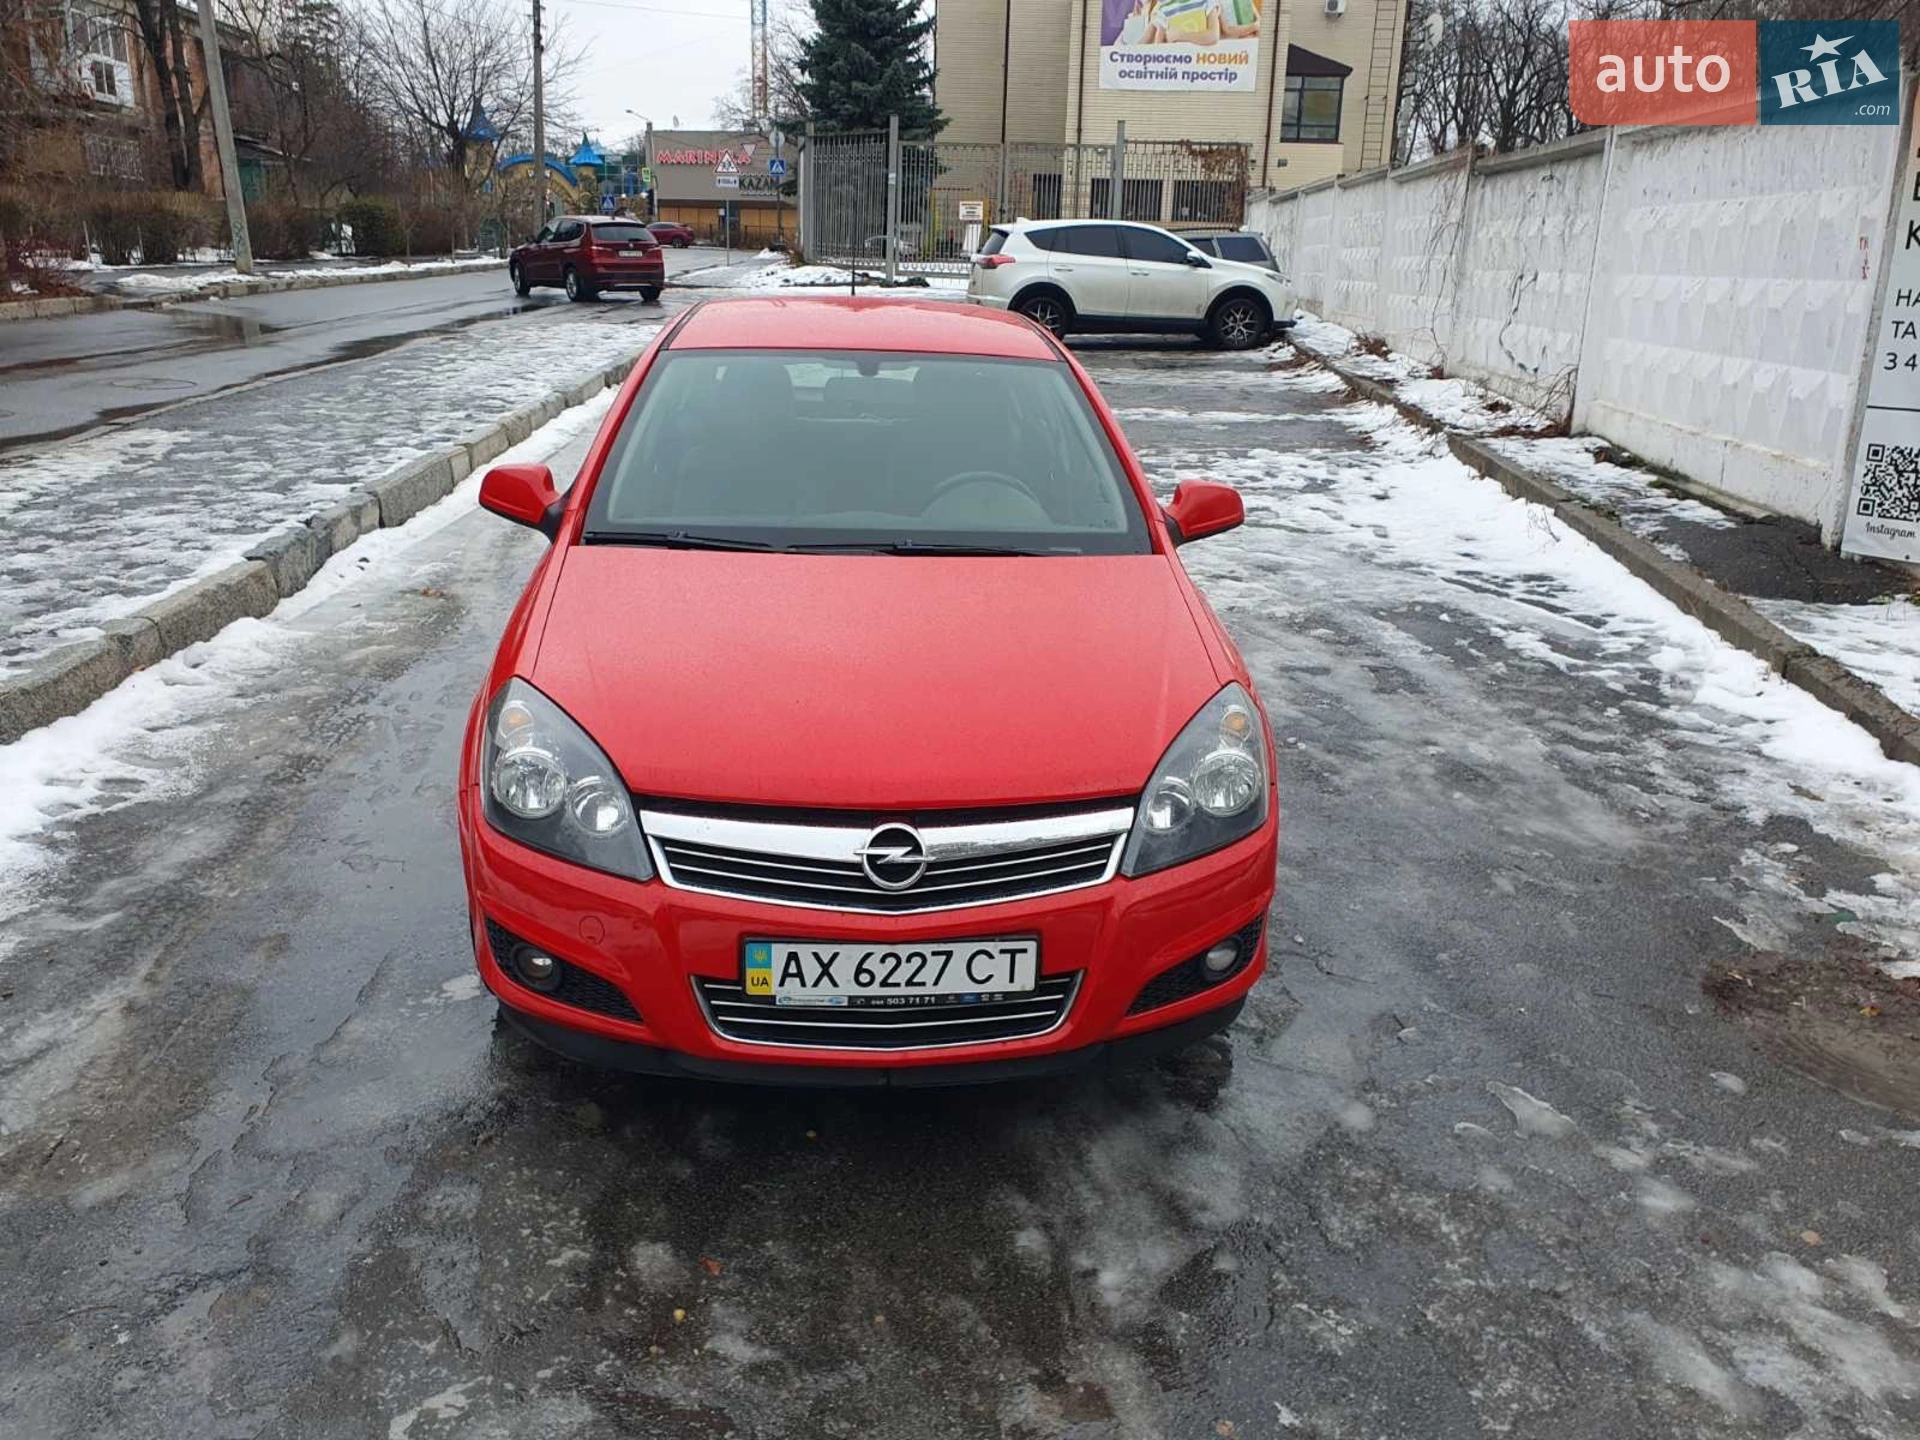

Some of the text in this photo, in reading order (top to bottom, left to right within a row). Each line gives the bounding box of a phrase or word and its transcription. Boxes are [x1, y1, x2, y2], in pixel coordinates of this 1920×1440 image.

[1109, 50, 1249, 66] Створюємо НОВИЙ
[1118, 67, 1237, 82] освітній простір
[1866, 522, 1916, 539] Instagram
[751, 948, 1028, 988] UA AX 6227 CT
